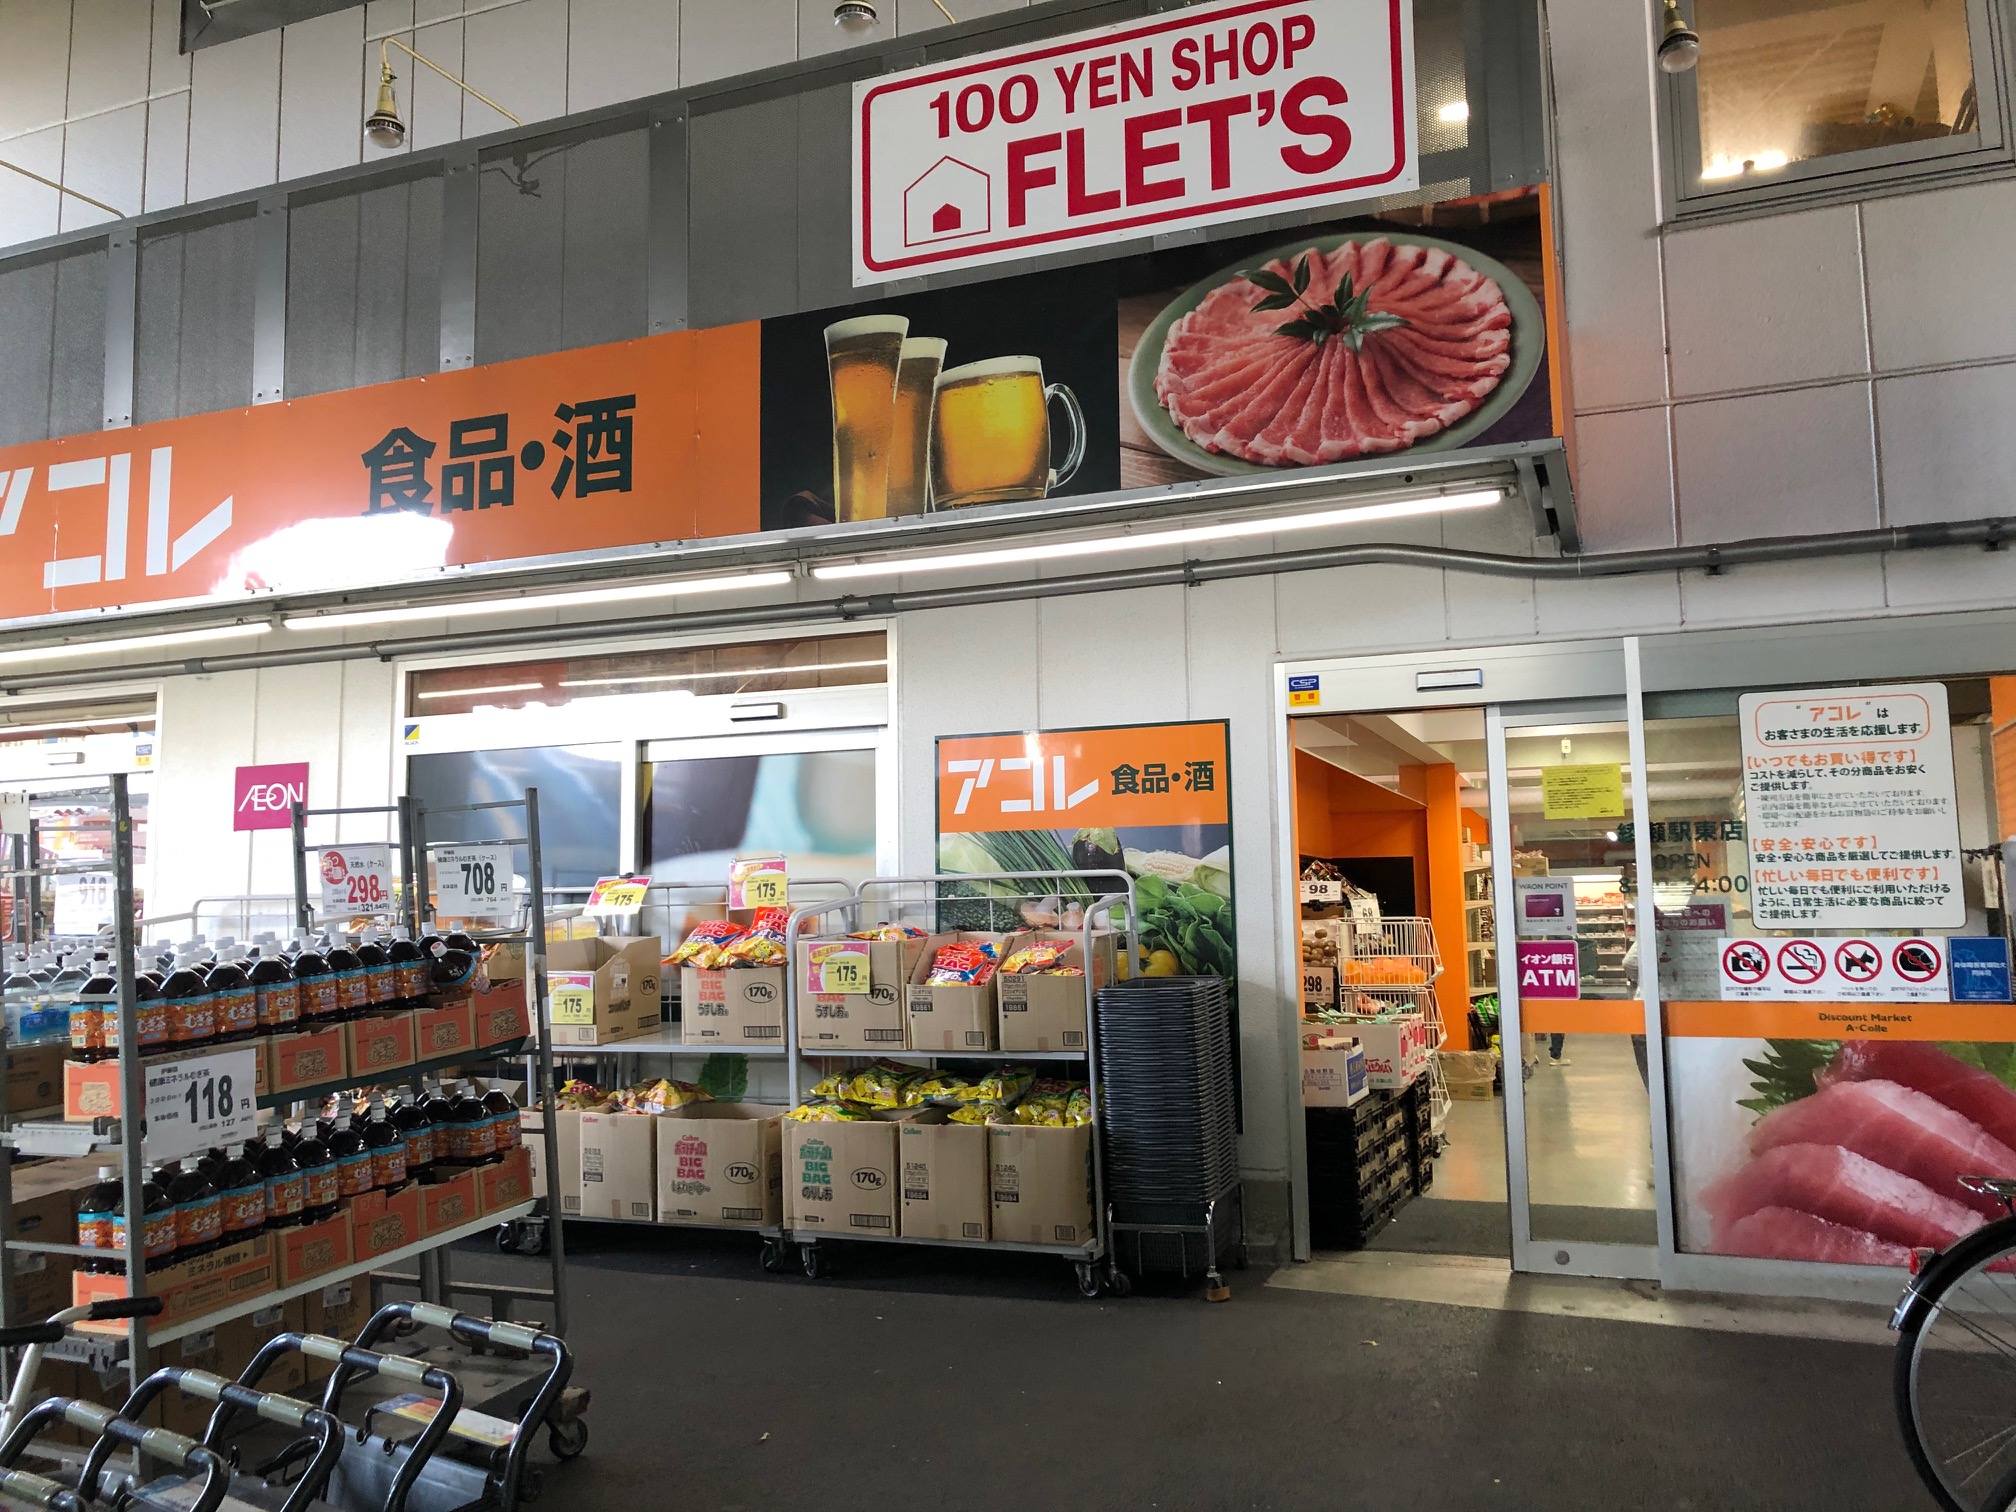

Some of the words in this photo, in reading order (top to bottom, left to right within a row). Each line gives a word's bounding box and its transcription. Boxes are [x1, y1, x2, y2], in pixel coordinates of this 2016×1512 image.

[929, 74, 1038, 138] 100
[1054, 47, 1153, 114] YEN
[1171, 14, 1316, 91] SHOP
[1007, 76, 1352, 228] FLET'S
[1290, 678, 1317, 688] CSP
[1765, 722, 1923, 741] お客さまの生活を応援します。
[1750, 764, 1926, 780] コストを減らして、その分商品をお安く
[948, 755, 1098, 814] アコレ
[1750, 781, 1813, 792] ご提供します。
[461, 862, 495, 895] 708
[346, 874, 380, 903] 298
[757, 882, 776, 898] 175
[1758, 884, 1950, 896] 忙しい毎日でも便利にご利用いただける
[614, 894, 633, 906] 175
[1758, 896, 1944, 907] ように、日常生活に必要な商品に絞って
[1760, 909, 1822, 920] ご提供します。
[934, 959, 970, 971] BAG
[1521, 953, 1574, 965] イオン銀行
[836, 965, 857, 982] 175
[1522, 969, 1576, 986] ATM
[748, 986, 772, 999] 170g
[563, 997, 582, 1014] 175
[1818, 1012, 1867, 1022] Discount
[1871, 1012, 1912, 1022] Market
[185, 1075, 234, 1124] 118
[679, 1157, 703, 1167] BIG
[805, 1162, 828, 1172] BIG
[676, 1168, 705, 1179] BAG
[729, 1166, 754, 1180] 170g
[802, 1173, 832, 1185] BAG
[855, 1171, 882, 1187] 170g
